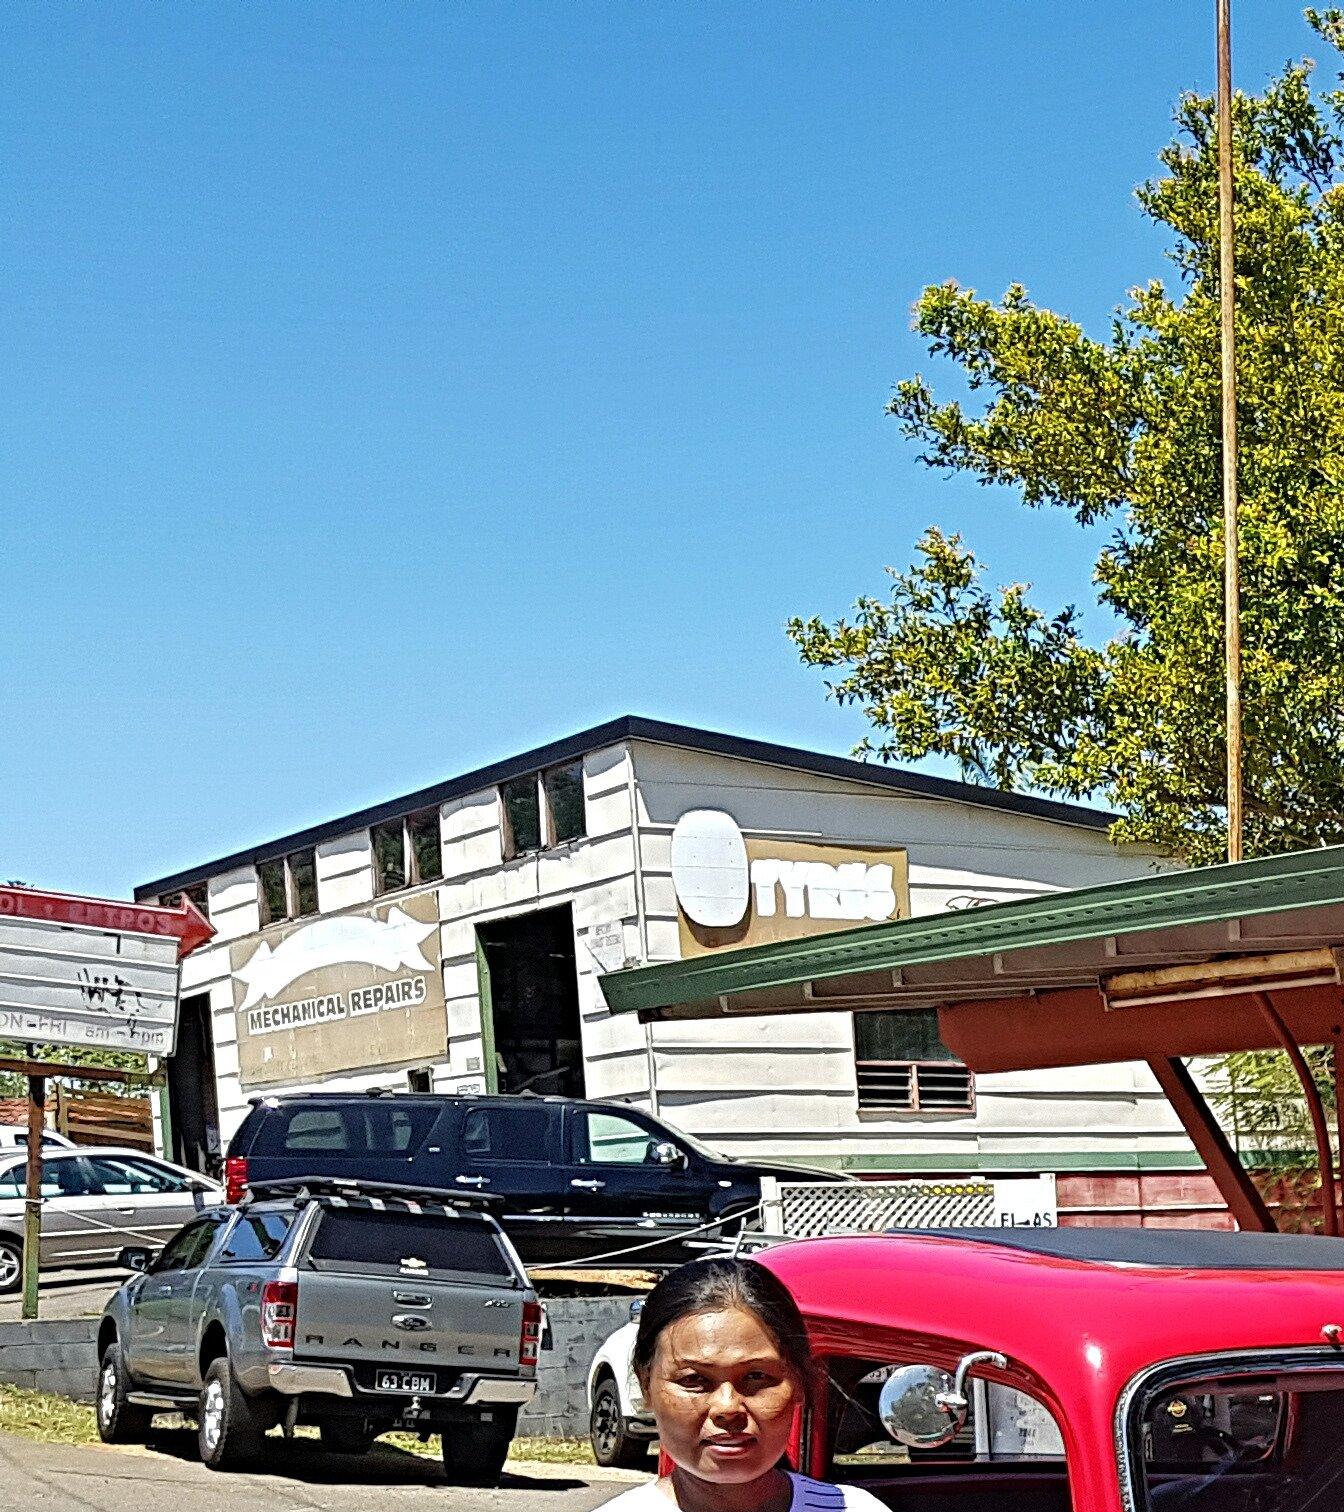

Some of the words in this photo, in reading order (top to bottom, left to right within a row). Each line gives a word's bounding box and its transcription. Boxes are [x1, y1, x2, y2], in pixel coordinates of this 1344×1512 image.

[250, 995, 346, 1031] MECHANICAL
[351, 976, 426, 1011] REPAIRS
[305, 1335, 511, 1357] RANGER
